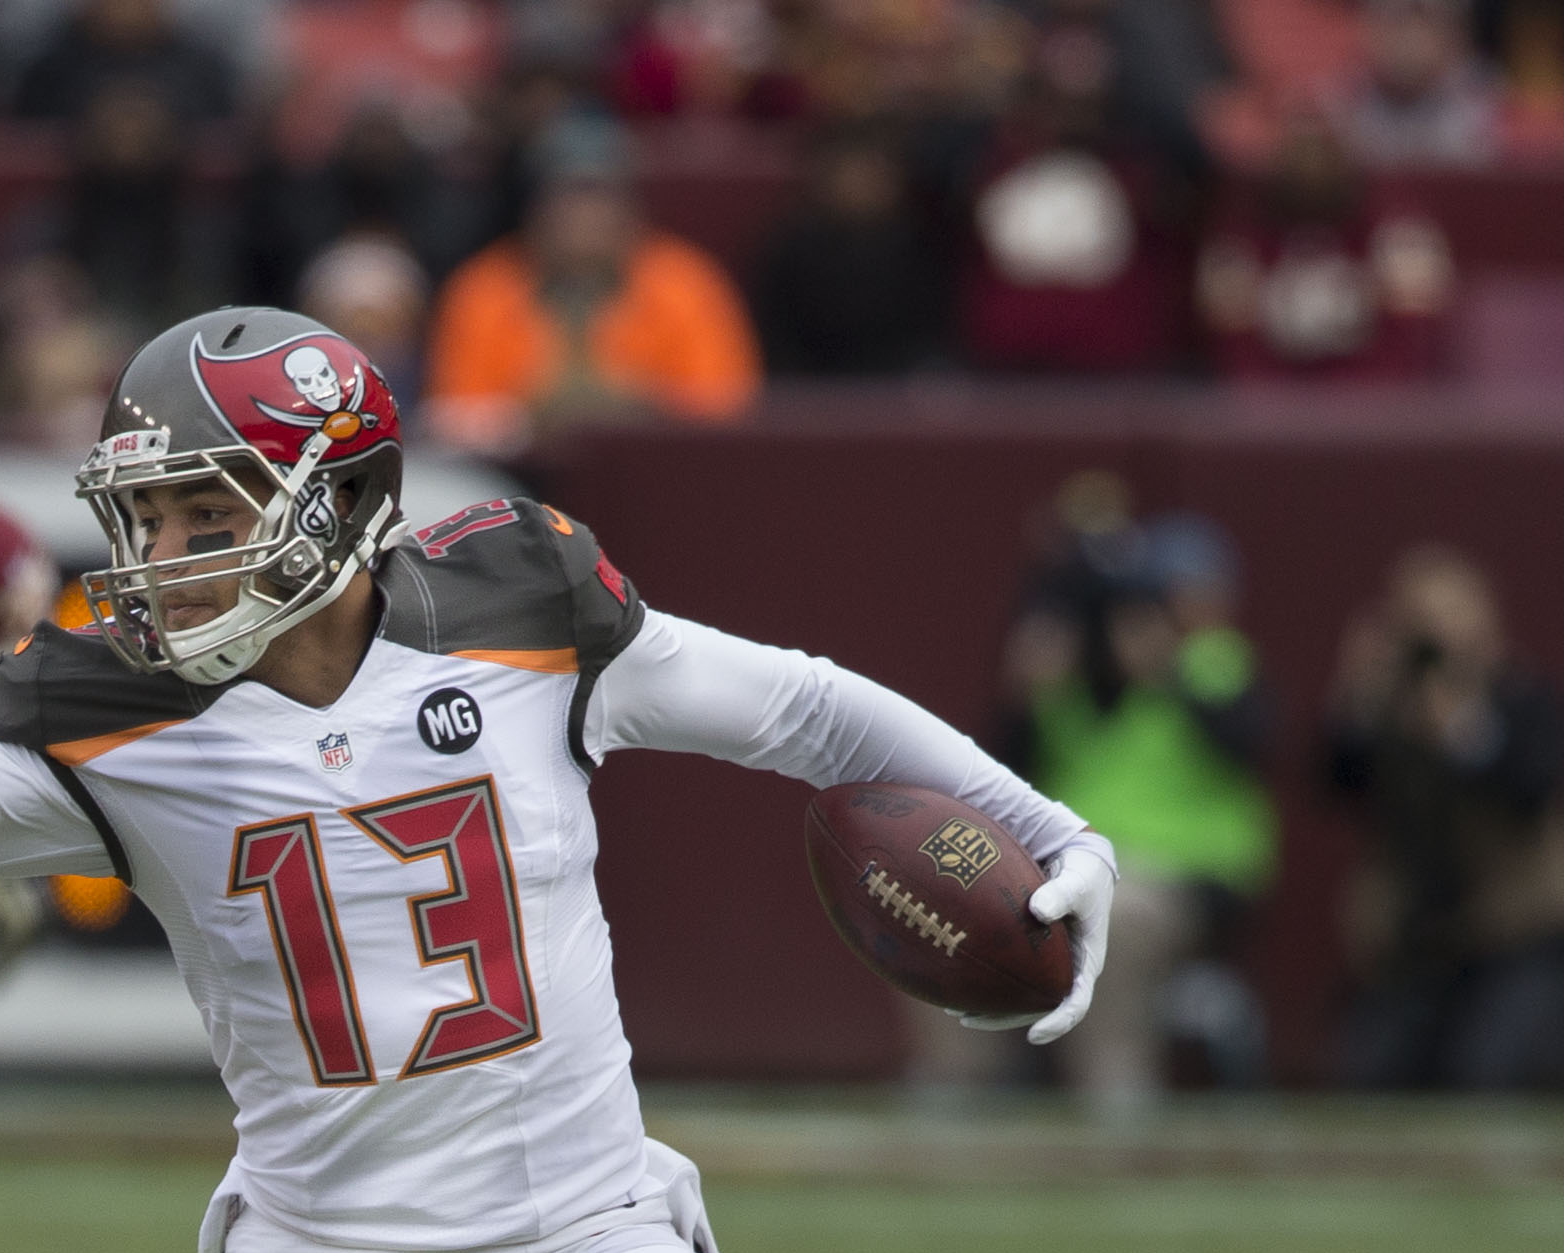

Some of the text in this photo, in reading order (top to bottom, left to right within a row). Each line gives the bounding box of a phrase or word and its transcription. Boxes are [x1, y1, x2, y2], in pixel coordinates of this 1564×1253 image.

[423, 697, 478, 746] MG
[323, 747, 350, 766] NFL
[947, 824, 994, 867] NFL
[227, 773, 542, 1088] 13
